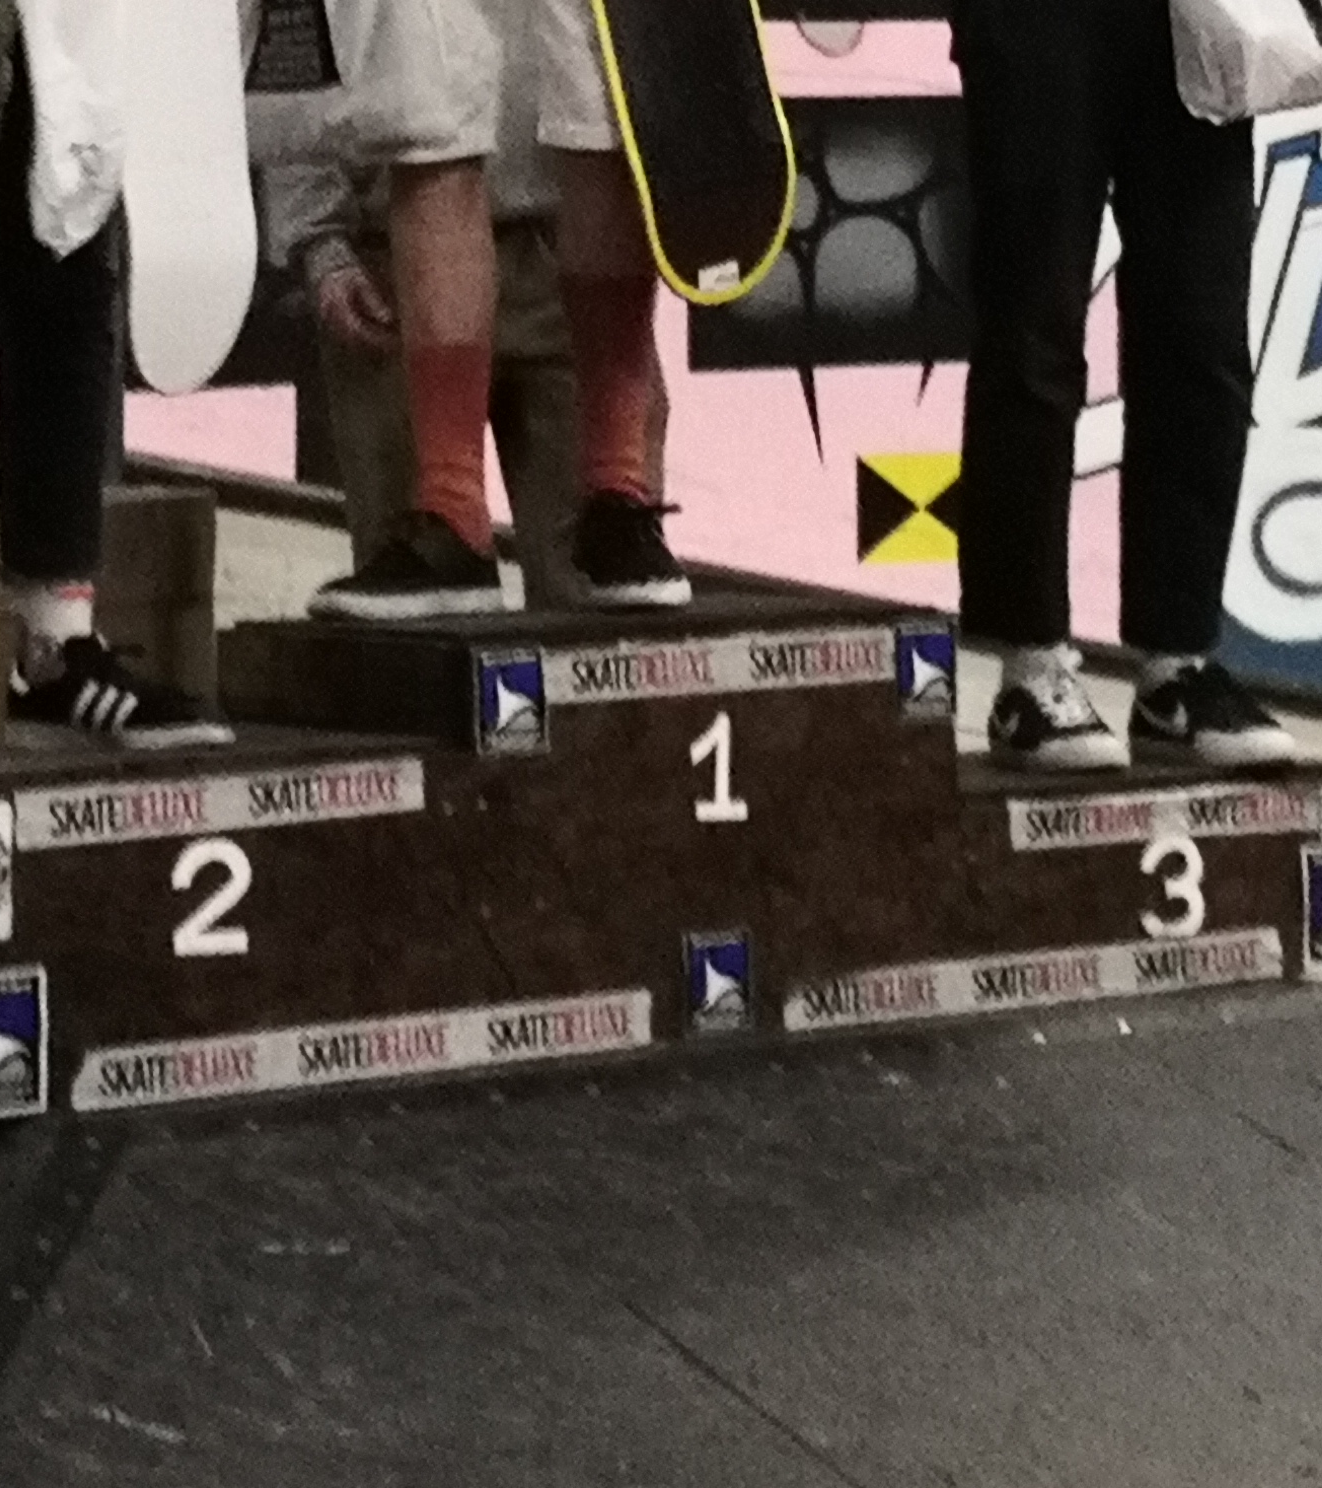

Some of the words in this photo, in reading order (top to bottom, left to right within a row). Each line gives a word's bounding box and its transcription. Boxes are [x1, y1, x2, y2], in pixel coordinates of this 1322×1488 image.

[48, 786, 205, 839] SKATEDELUXE
[248, 768, 400, 817] SKATEDELUXE
[689, 712, 749, 822] 1
[171, 839, 253, 957] 2
[1141, 837, 1204, 938] 3
[99, 1043, 257, 1097] SKATEDELUXE
[297, 1023, 448, 1073] SKATEDELUXE
[487, 1003, 629, 1052] SKATEDELUXE
